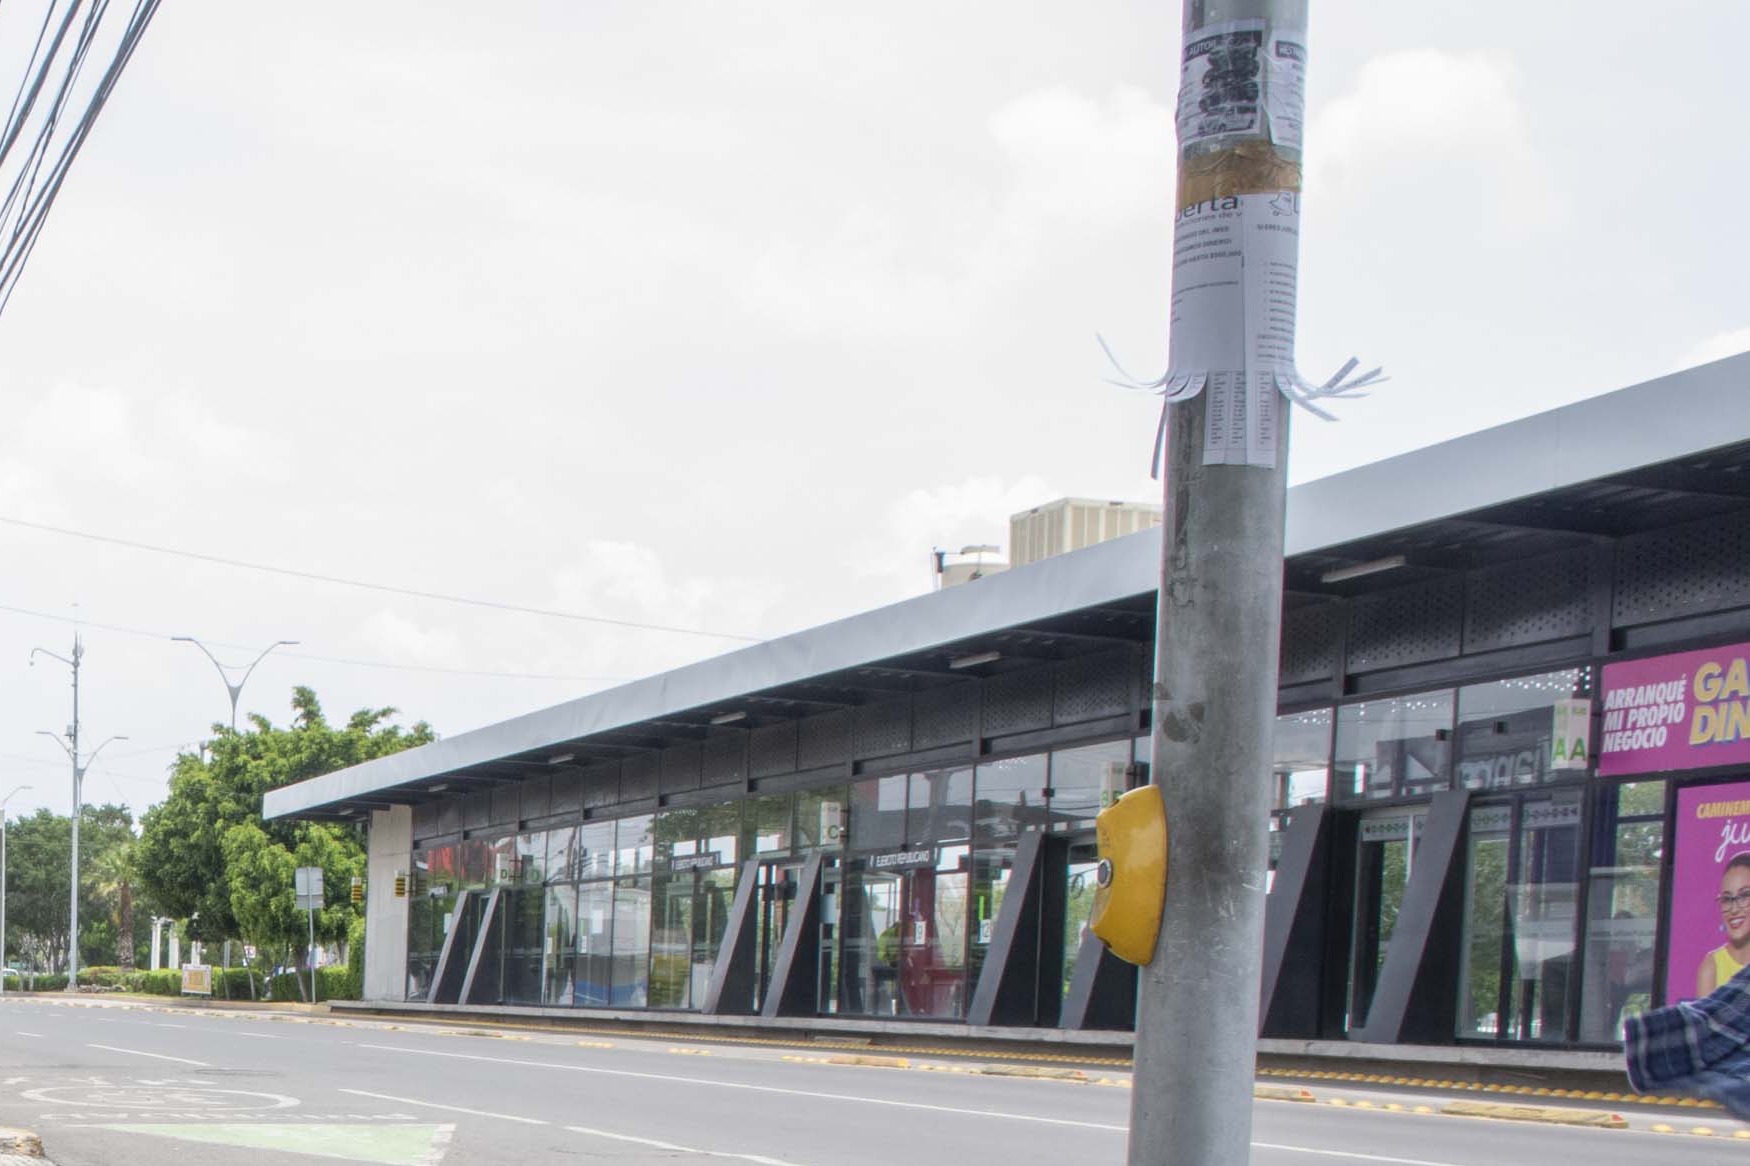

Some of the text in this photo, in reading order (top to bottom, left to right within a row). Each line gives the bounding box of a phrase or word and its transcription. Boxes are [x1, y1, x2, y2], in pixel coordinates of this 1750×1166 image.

[1604, 673, 1687, 711] ARRANQUÉ
[1603, 702, 1685, 732] MI PROPIO
[1602, 726, 1667, 753] NEGOCIO
